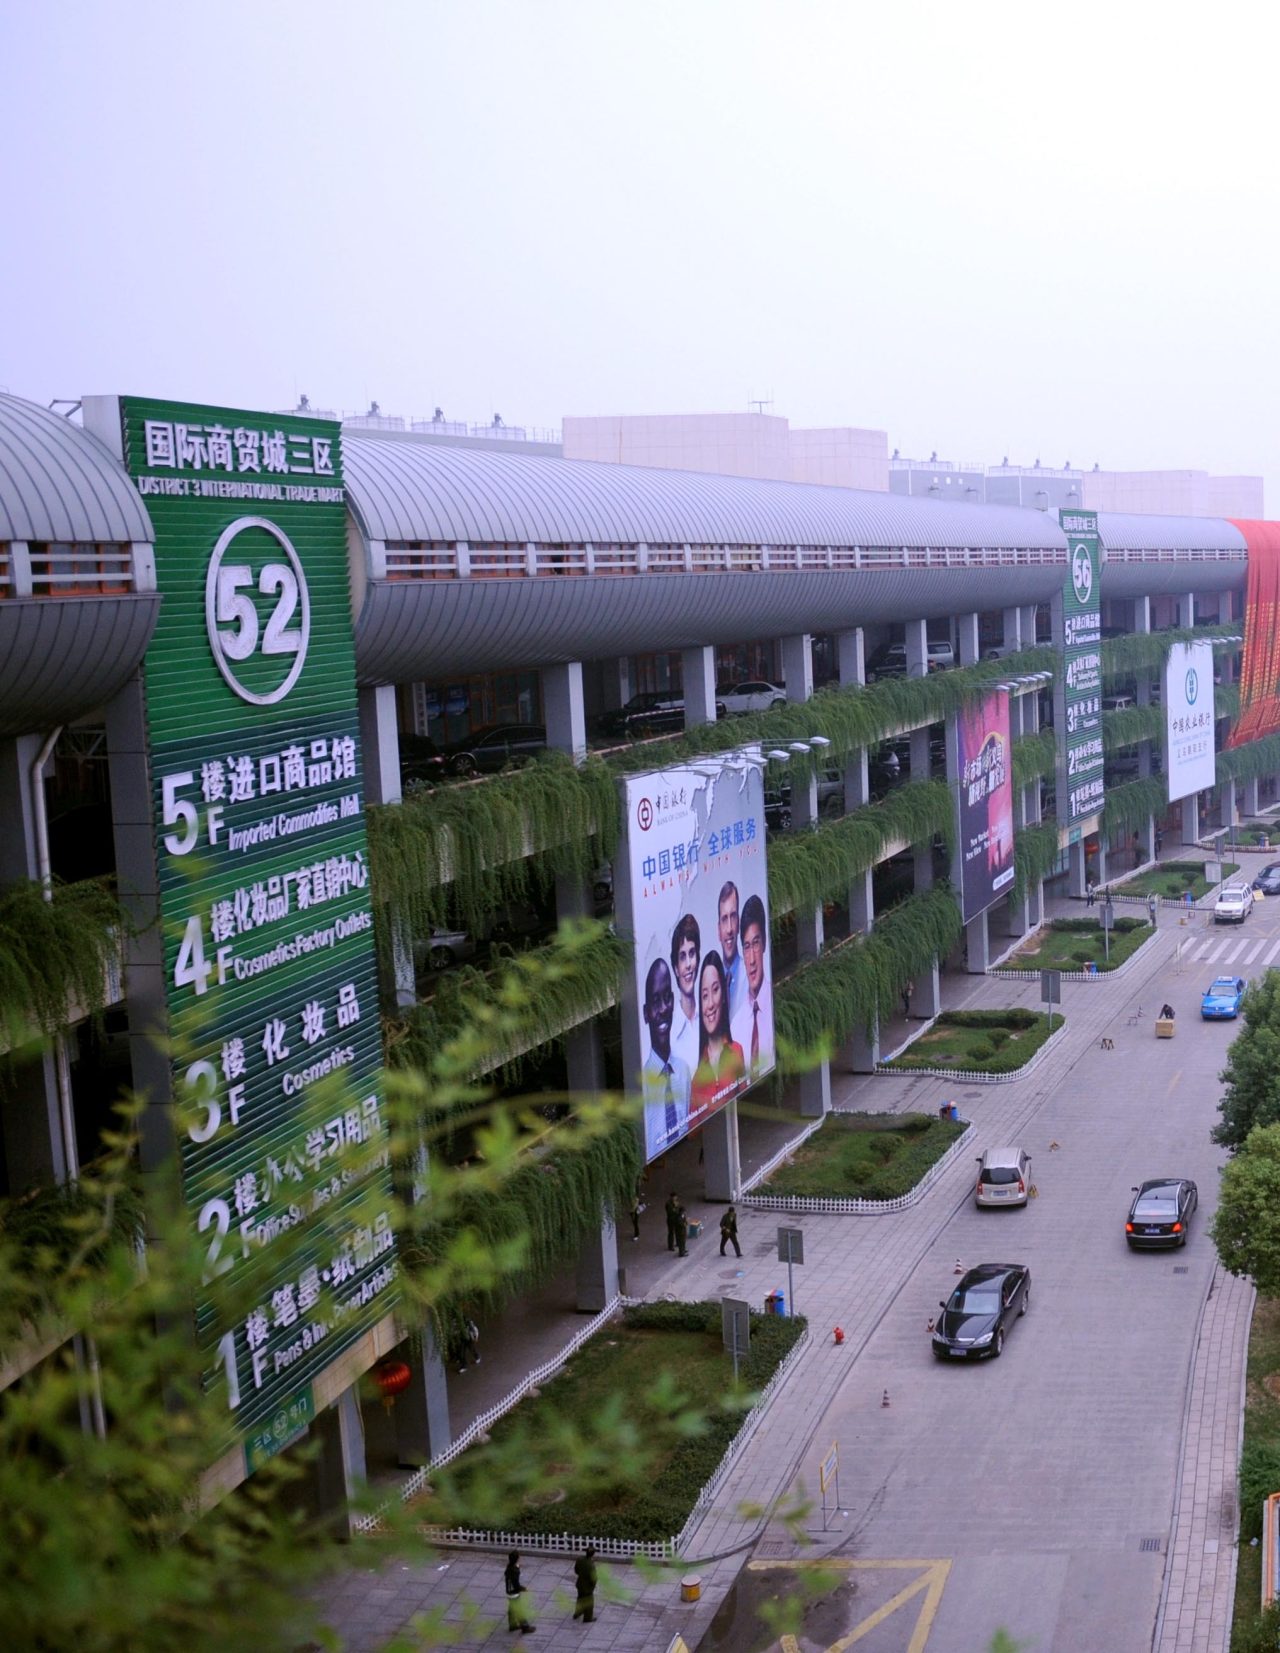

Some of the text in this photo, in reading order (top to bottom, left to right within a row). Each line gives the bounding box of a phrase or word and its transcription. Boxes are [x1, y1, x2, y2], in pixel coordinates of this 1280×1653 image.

[144, 420, 336, 476] 国际商贸城三区
[138, 476, 190, 496] DISTRICT
[192, 479, 201, 496] 3
[201, 480, 285, 500] INTERNATIONAL
[1074, 558, 1091, 588] 56
[217, 563, 302, 660] 52
[200, 735, 356, 804] 楼进口商品馆
[229, 815, 276, 852] Imported
[278, 800, 338, 837] Commodities
[642, 818, 756, 880] 中国银行 全球服务
[210, 850, 368, 943] 楼化妆品厂家直销中心
[643, 869, 691, 898] ALWAYS
[233, 942, 296, 981] Cosmetics
[221, 983, 361, 1081] 楼化妆品
[282, 1046, 355, 1095] Cosmetics
[274, 1341, 303, 1375] Pens
